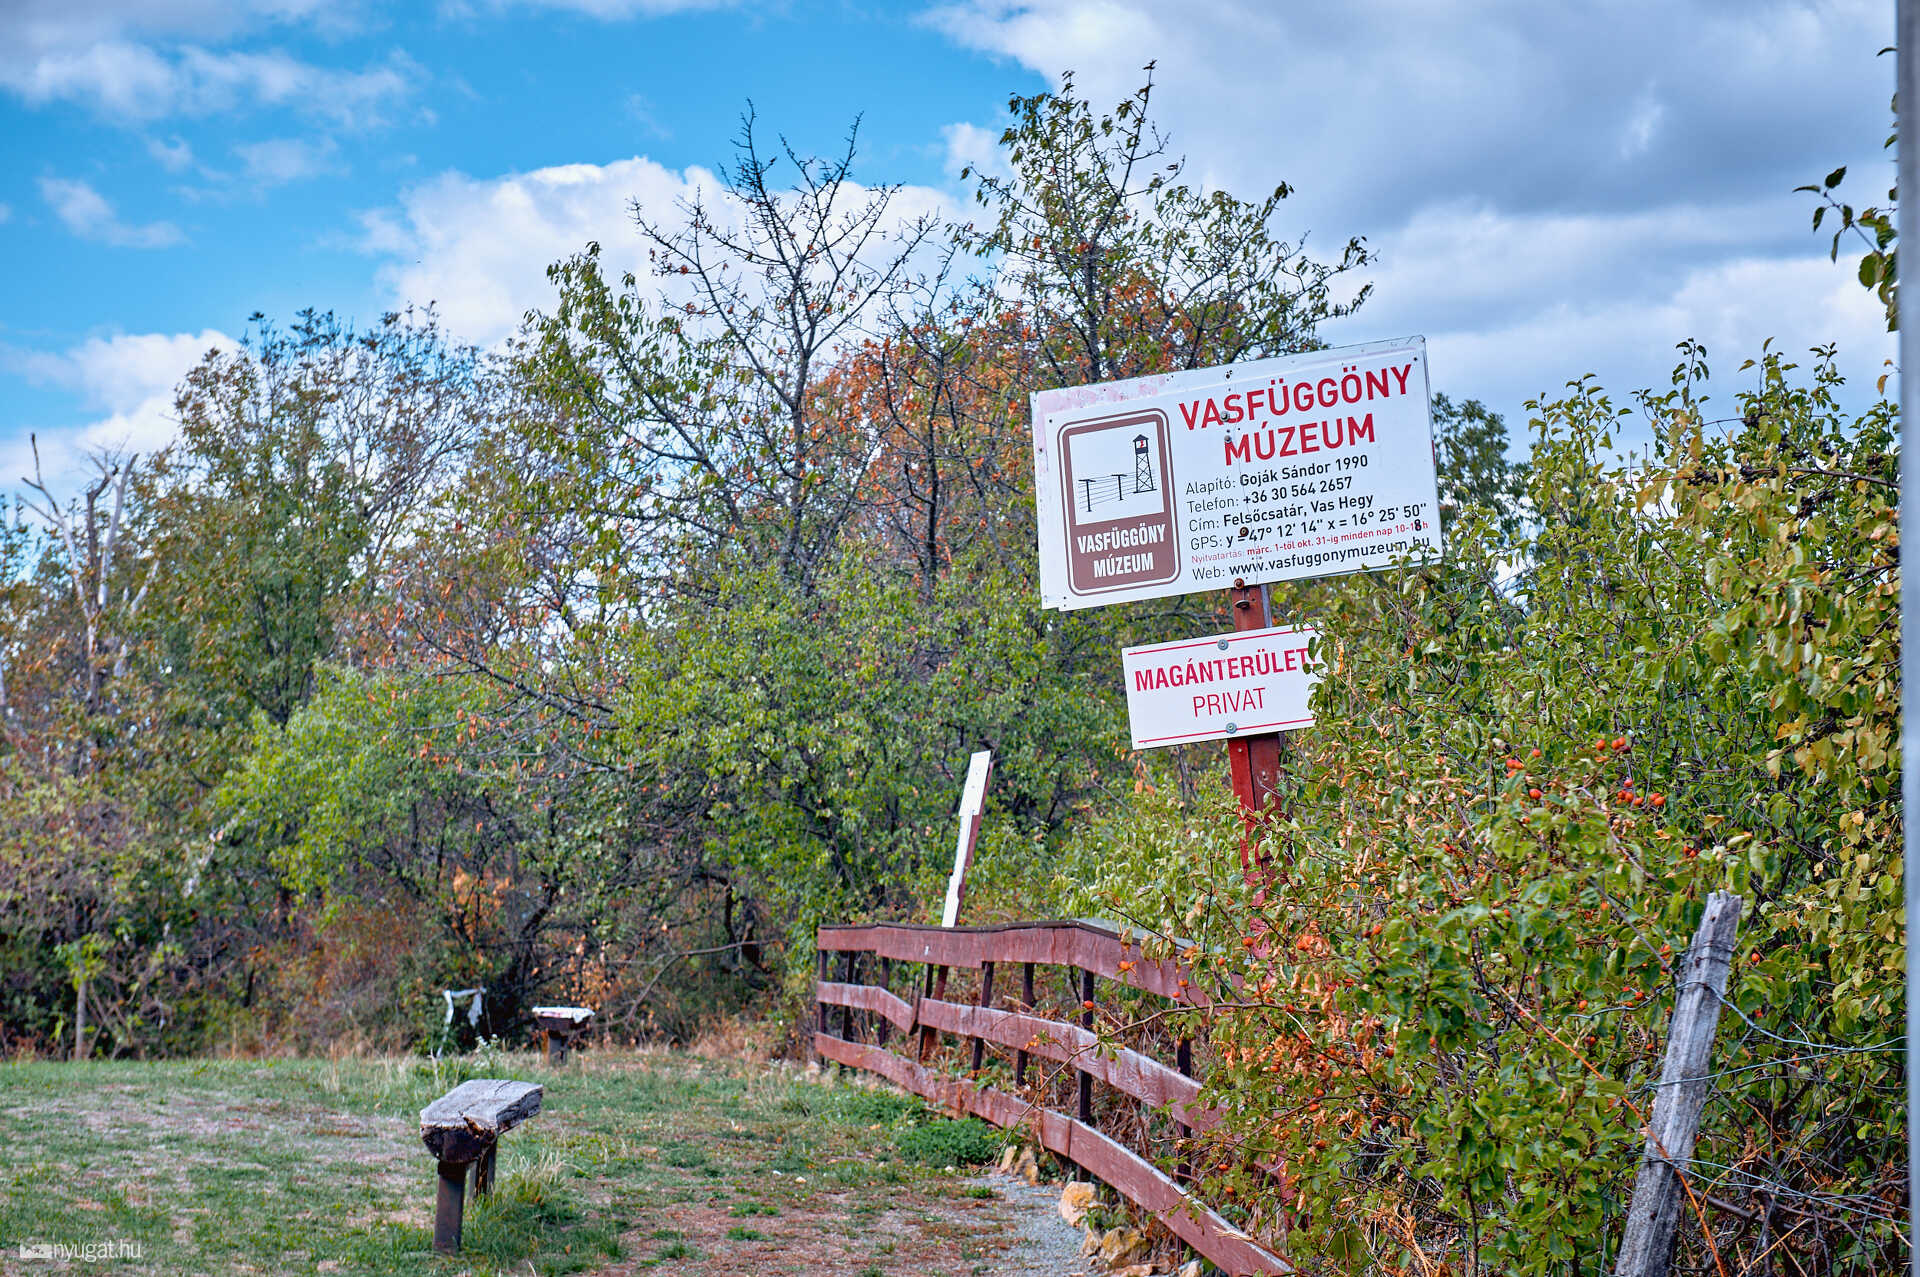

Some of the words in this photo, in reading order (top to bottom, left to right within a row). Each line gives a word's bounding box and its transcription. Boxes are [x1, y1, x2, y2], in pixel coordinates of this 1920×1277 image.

[1179, 364, 1411, 431] VASFÜGGÖNY
[1224, 413, 1375, 466] MÚZEUM
[1186, 476, 1236, 495] Alapító:
[1240, 470, 1278, 487] Goják
[1282, 463, 1331, 480] Sándor
[1336, 455, 1368, 471] 1990
[1187, 497, 1239, 513] Telefon:
[1243, 490, 1267, 504] +36
[1271, 487, 1288, 501] 30
[1291, 482, 1316, 497] 564
[1320, 476, 1352, 493] 2657
[1189, 518, 1220, 532] Cím:
[1224, 503, 1307, 527] Felsőcsatár,
[1310, 500, 1335, 513] Vas
[1338, 495, 1373, 509] Hegy
[1190, 535, 1222, 550] GPS:
[1226, 536, 1234, 548] y
[1249, 527, 1272, 541] 47°
[1327, 520, 1336, 530] x
[1351, 511, 1374, 526] 16°
[1077, 522, 1166, 554] VASFÜGGÖNY
[1247, 545, 1273, 556] márc.
[1297, 539, 1314, 548] okt.
[1341, 530, 1374, 542] minden
[1376, 528, 1392, 537] nap
[1093, 552, 1154, 578] MÚZEUM
[1192, 565, 1225, 580] Web:
[1229, 536, 1430, 576] www.vasfuggonymuzeumhu
[1193, 687, 1266, 718] PRIVAT
